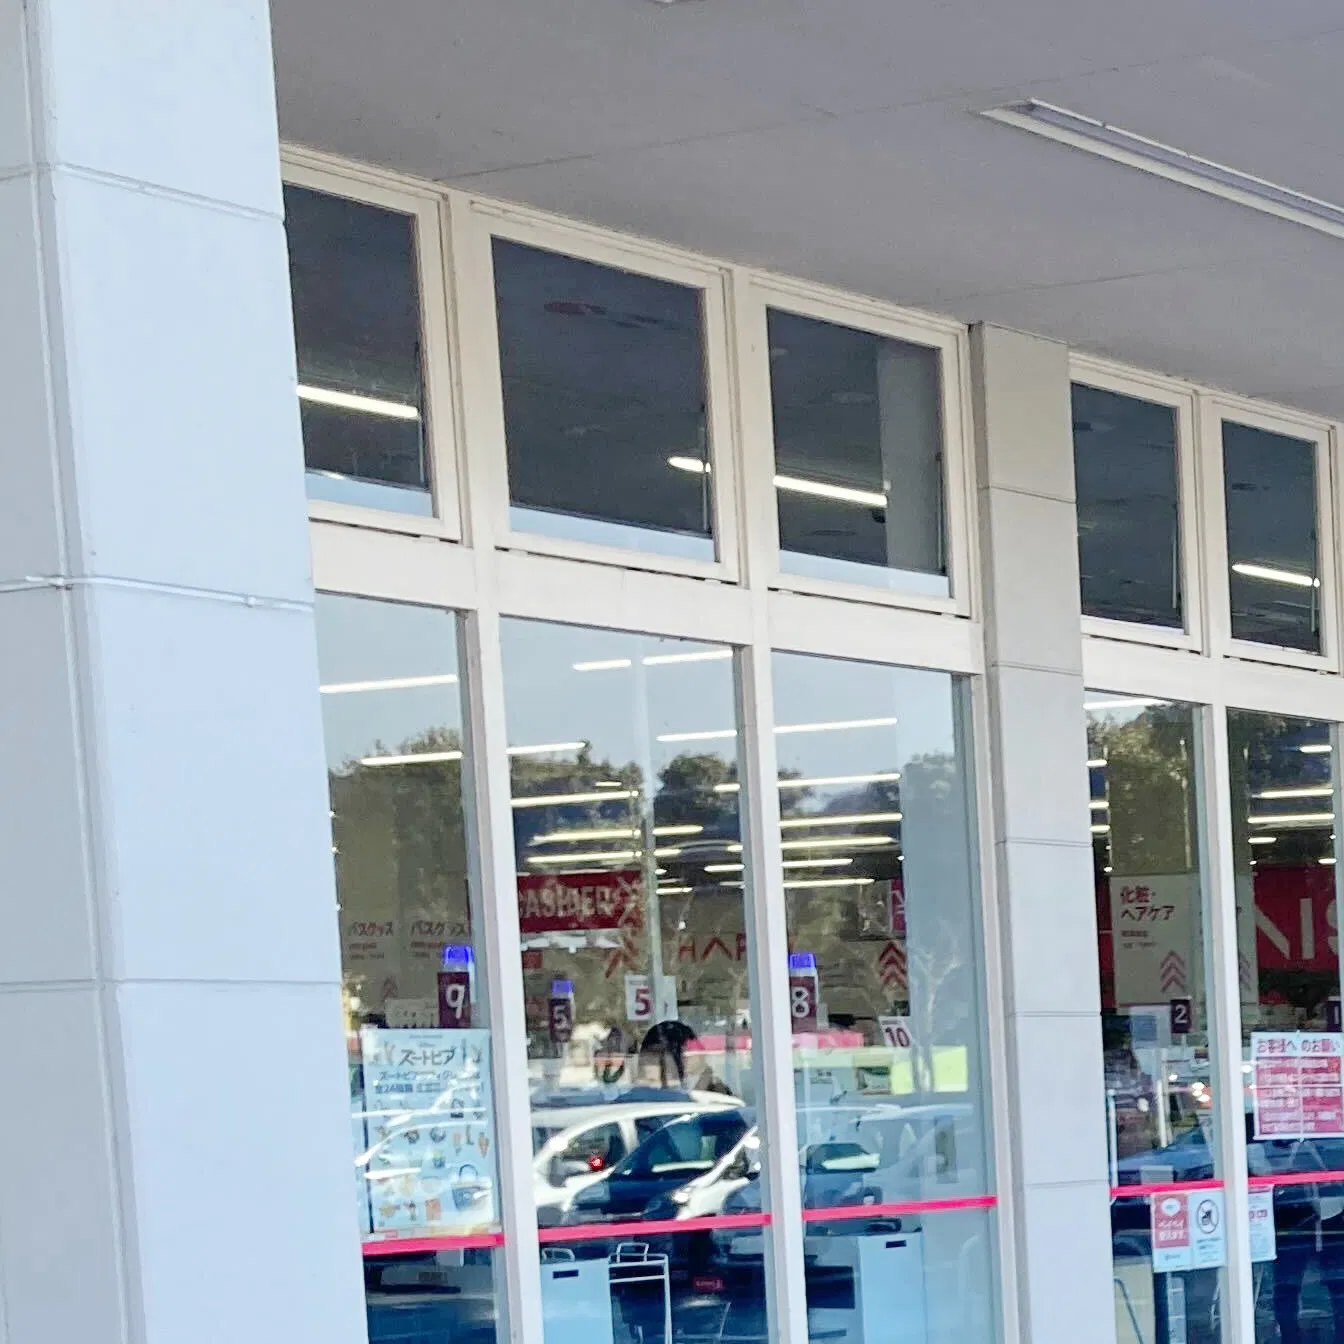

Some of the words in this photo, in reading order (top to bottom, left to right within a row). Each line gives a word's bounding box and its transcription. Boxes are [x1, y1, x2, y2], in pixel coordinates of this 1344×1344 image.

[1120, 905, 1175, 922] ヘアケア
[446, 983, 466, 1020] 9
[634, 987, 652, 1017] 5
[791, 985, 811, 1019] 8
[1174, 1004, 1189, 1024] 2
[885, 1026, 912, 1049] 10
